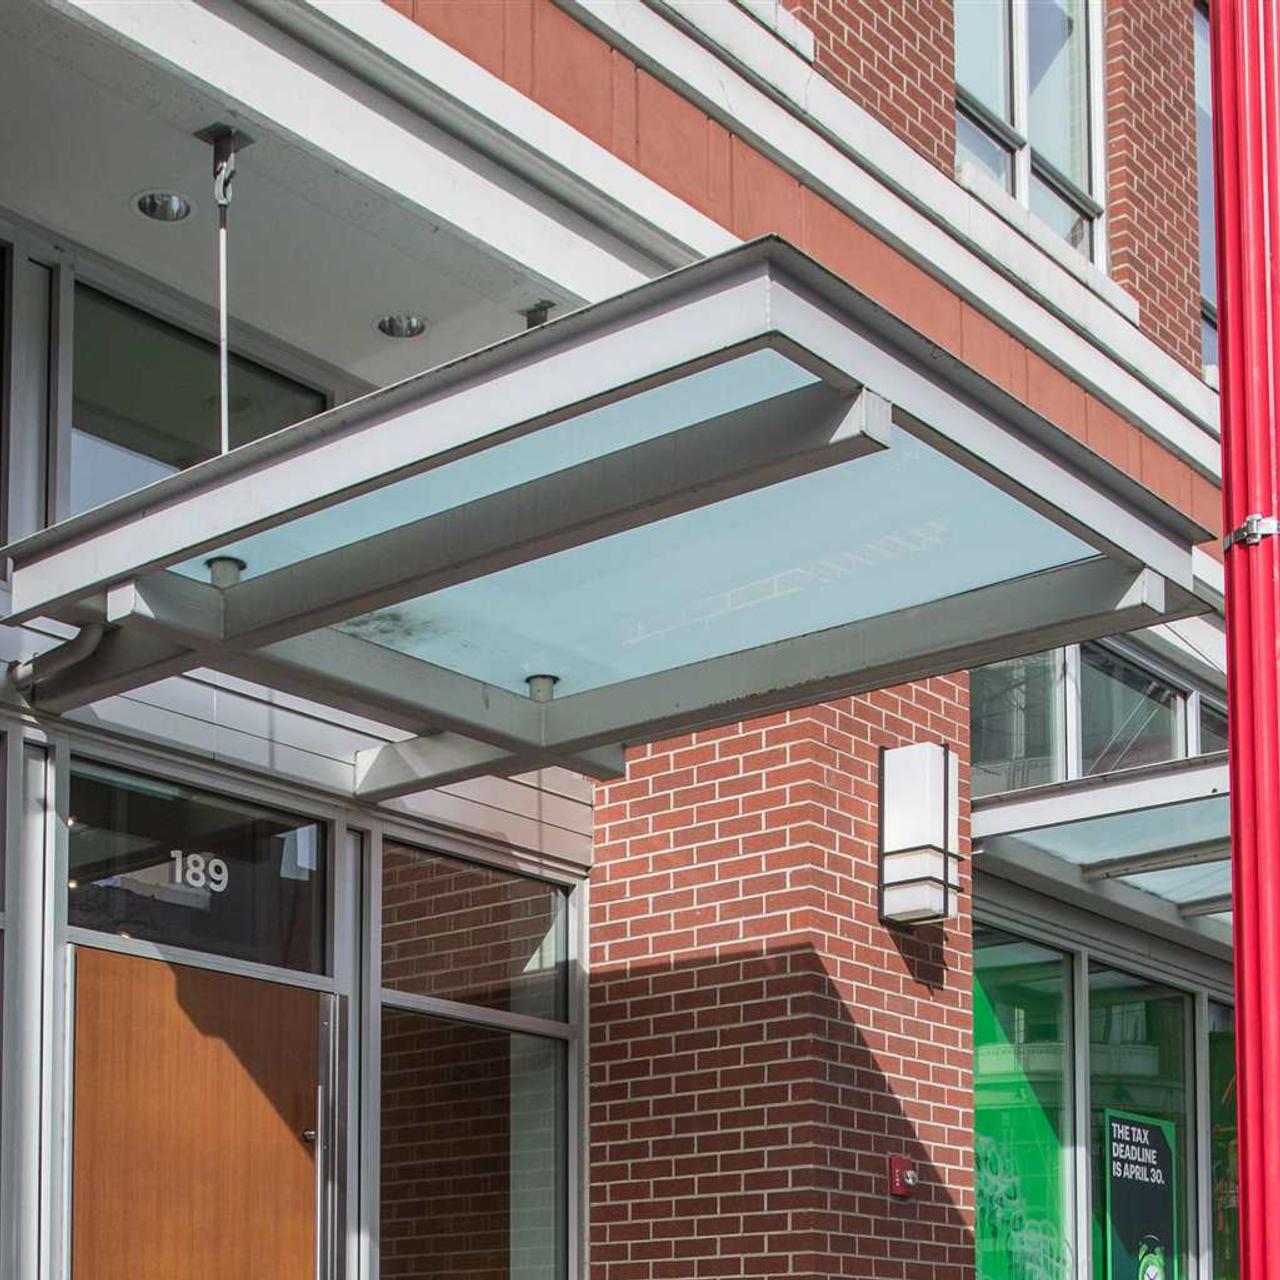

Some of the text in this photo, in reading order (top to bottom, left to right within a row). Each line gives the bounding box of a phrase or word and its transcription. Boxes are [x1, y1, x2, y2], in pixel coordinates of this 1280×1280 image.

[170, 850, 229, 892] 189
[1111, 1122, 1149, 1145] THE TAX
[1112, 1142, 1158, 1166] DEADLINE
[1112, 1160, 1165, 1184] IS APRIL 30.
